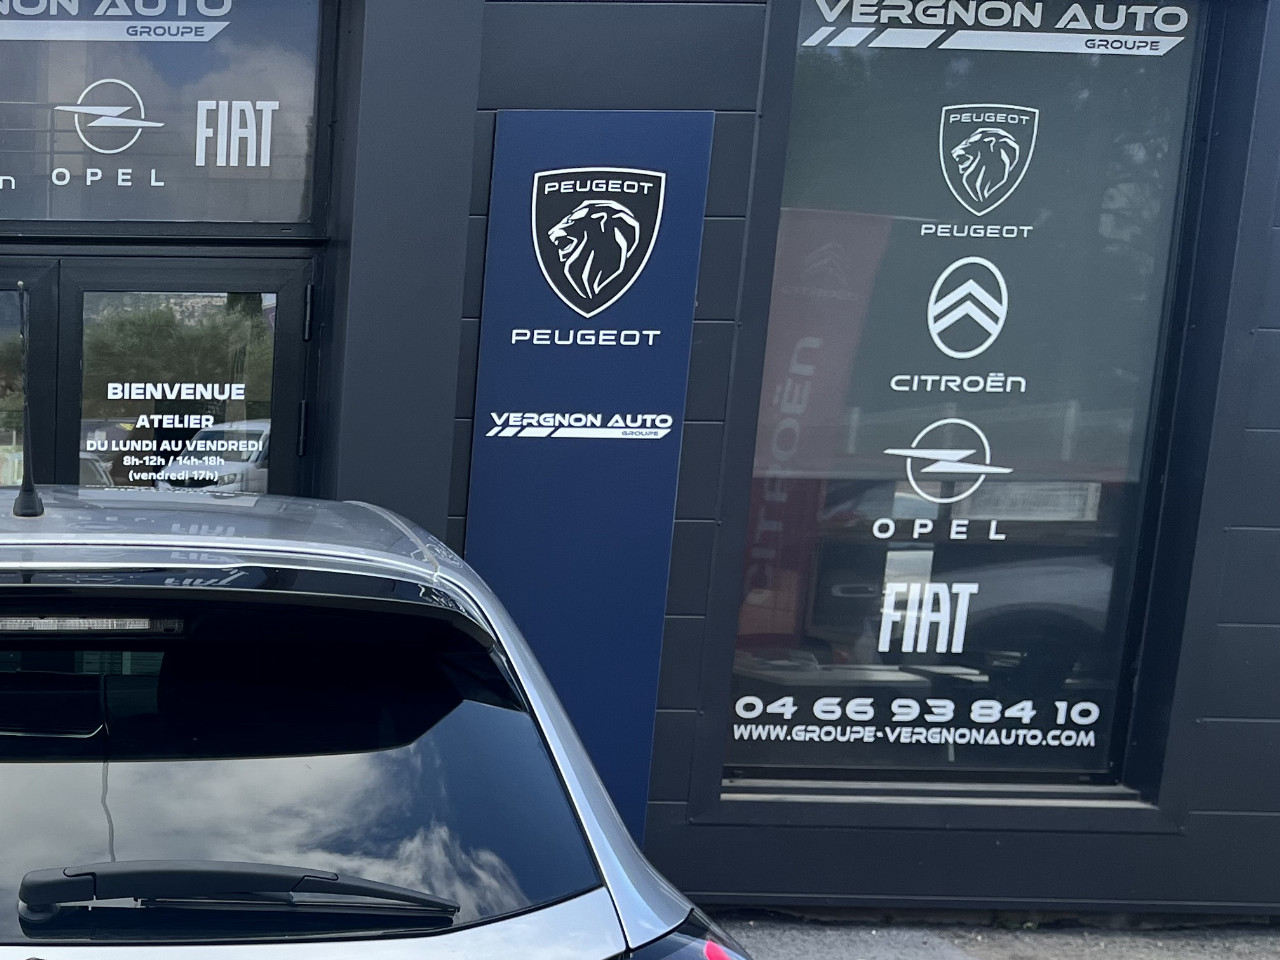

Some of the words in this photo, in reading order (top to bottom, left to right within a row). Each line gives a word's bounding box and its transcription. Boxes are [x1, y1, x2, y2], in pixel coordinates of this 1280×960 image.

[94, 0, 231, 16] AUTO
[815, 0, 1042, 28] VERGNON
[1055, 3, 1187, 33] AUTO
[127, 26, 204, 37] GROUPE
[1084, 39, 1160, 52] GROUPE
[949, 113, 1030, 125] PEUGEOT
[196, 101, 279, 166] FIAT
[52, 168, 164, 187] OPEL
[545, 180, 653, 194] PEUGEOT
[921, 224, 1033, 238] PEUGEOT
[512, 329, 661, 346] PEUGEOT
[107, 383, 245, 400] BIENVENUE
[135, 414, 214, 429] ATELIER
[491, 412, 602, 427] VERGNON
[606, 414, 673, 428] AUTO
[86, 440, 108, 451] DU
[111, 440, 157, 451] LUNDI
[160, 440, 183, 451] AU
[185, 440, 263, 451] VENDREDI
[123, 455, 166, 466] 8h-12h
[176, 456, 225, 466] 14h-18h
[128, 471, 189, 482] (vendredi
[192, 471, 219, 482] 17h)
[872, 517, 1006, 540] OPEL
[878, 583, 979, 653] FIAT
[734, 696, 798, 719] 04
[812, 697, 876, 721] 66
[890, 699, 955, 722] 93
[970, 700, 1036, 724] 84
[1055, 701, 1100, 725] 10
[733, 724, 1097, 747] WWW.GROUPE-VERGNONAUTO.COM
